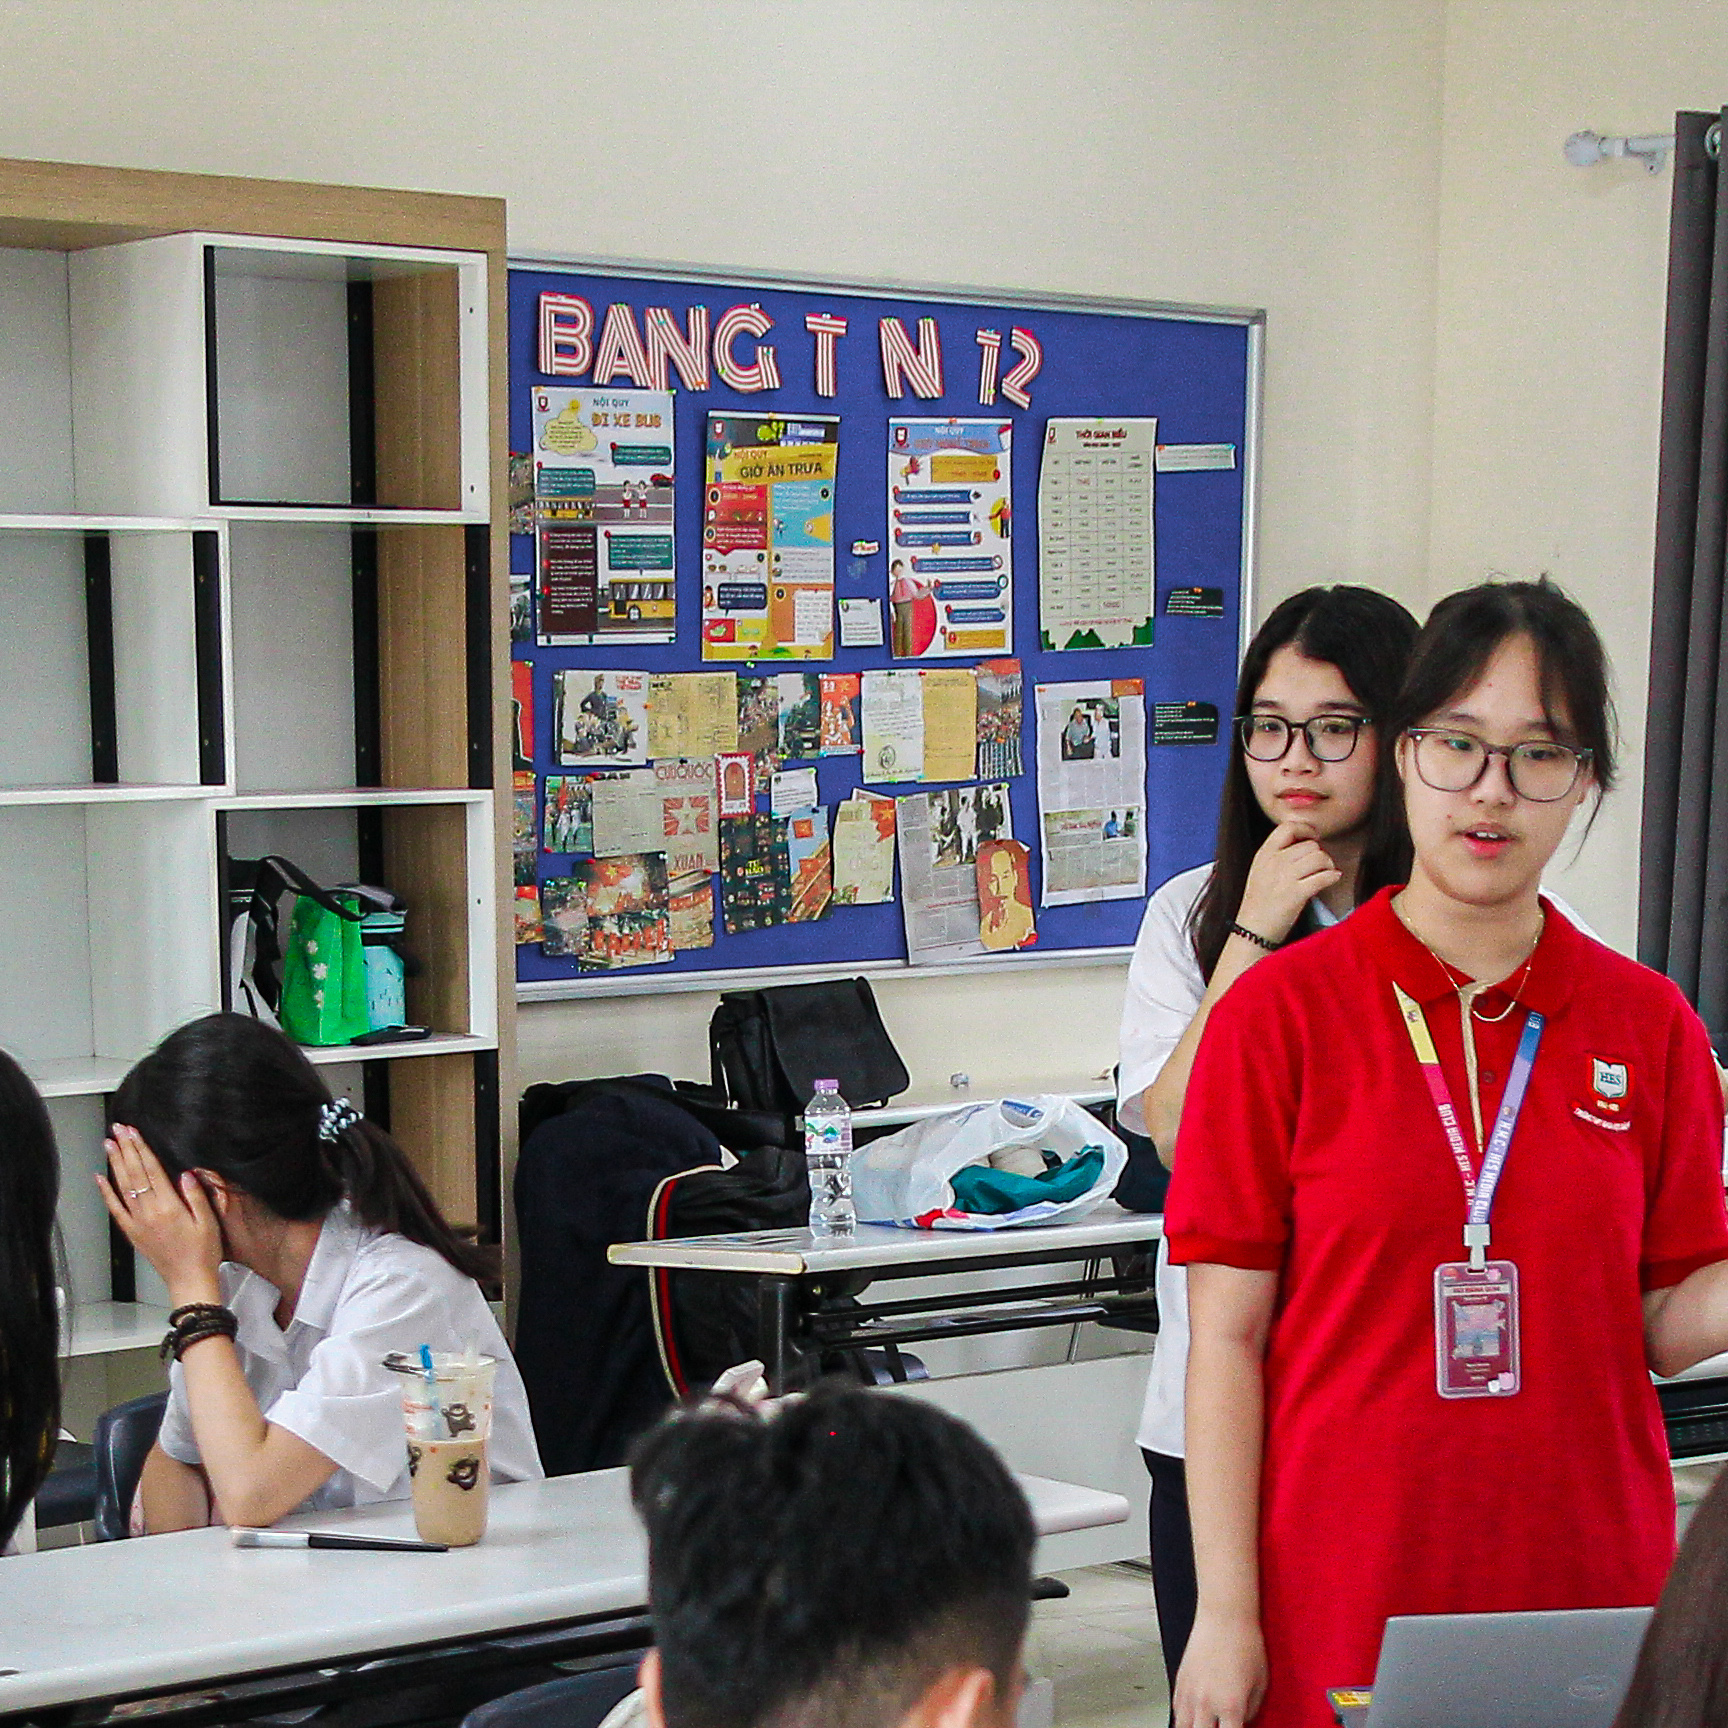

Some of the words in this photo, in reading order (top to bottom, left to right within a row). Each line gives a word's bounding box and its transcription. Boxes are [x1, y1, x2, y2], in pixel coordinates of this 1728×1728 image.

[805, 313, 848, 397] T
[879, 317, 944, 399] N
[976, 325, 1044, 410] 12
[1599, 1072, 1622, 1086] HES
[1437, 1103, 1457, 1123] CLUB
